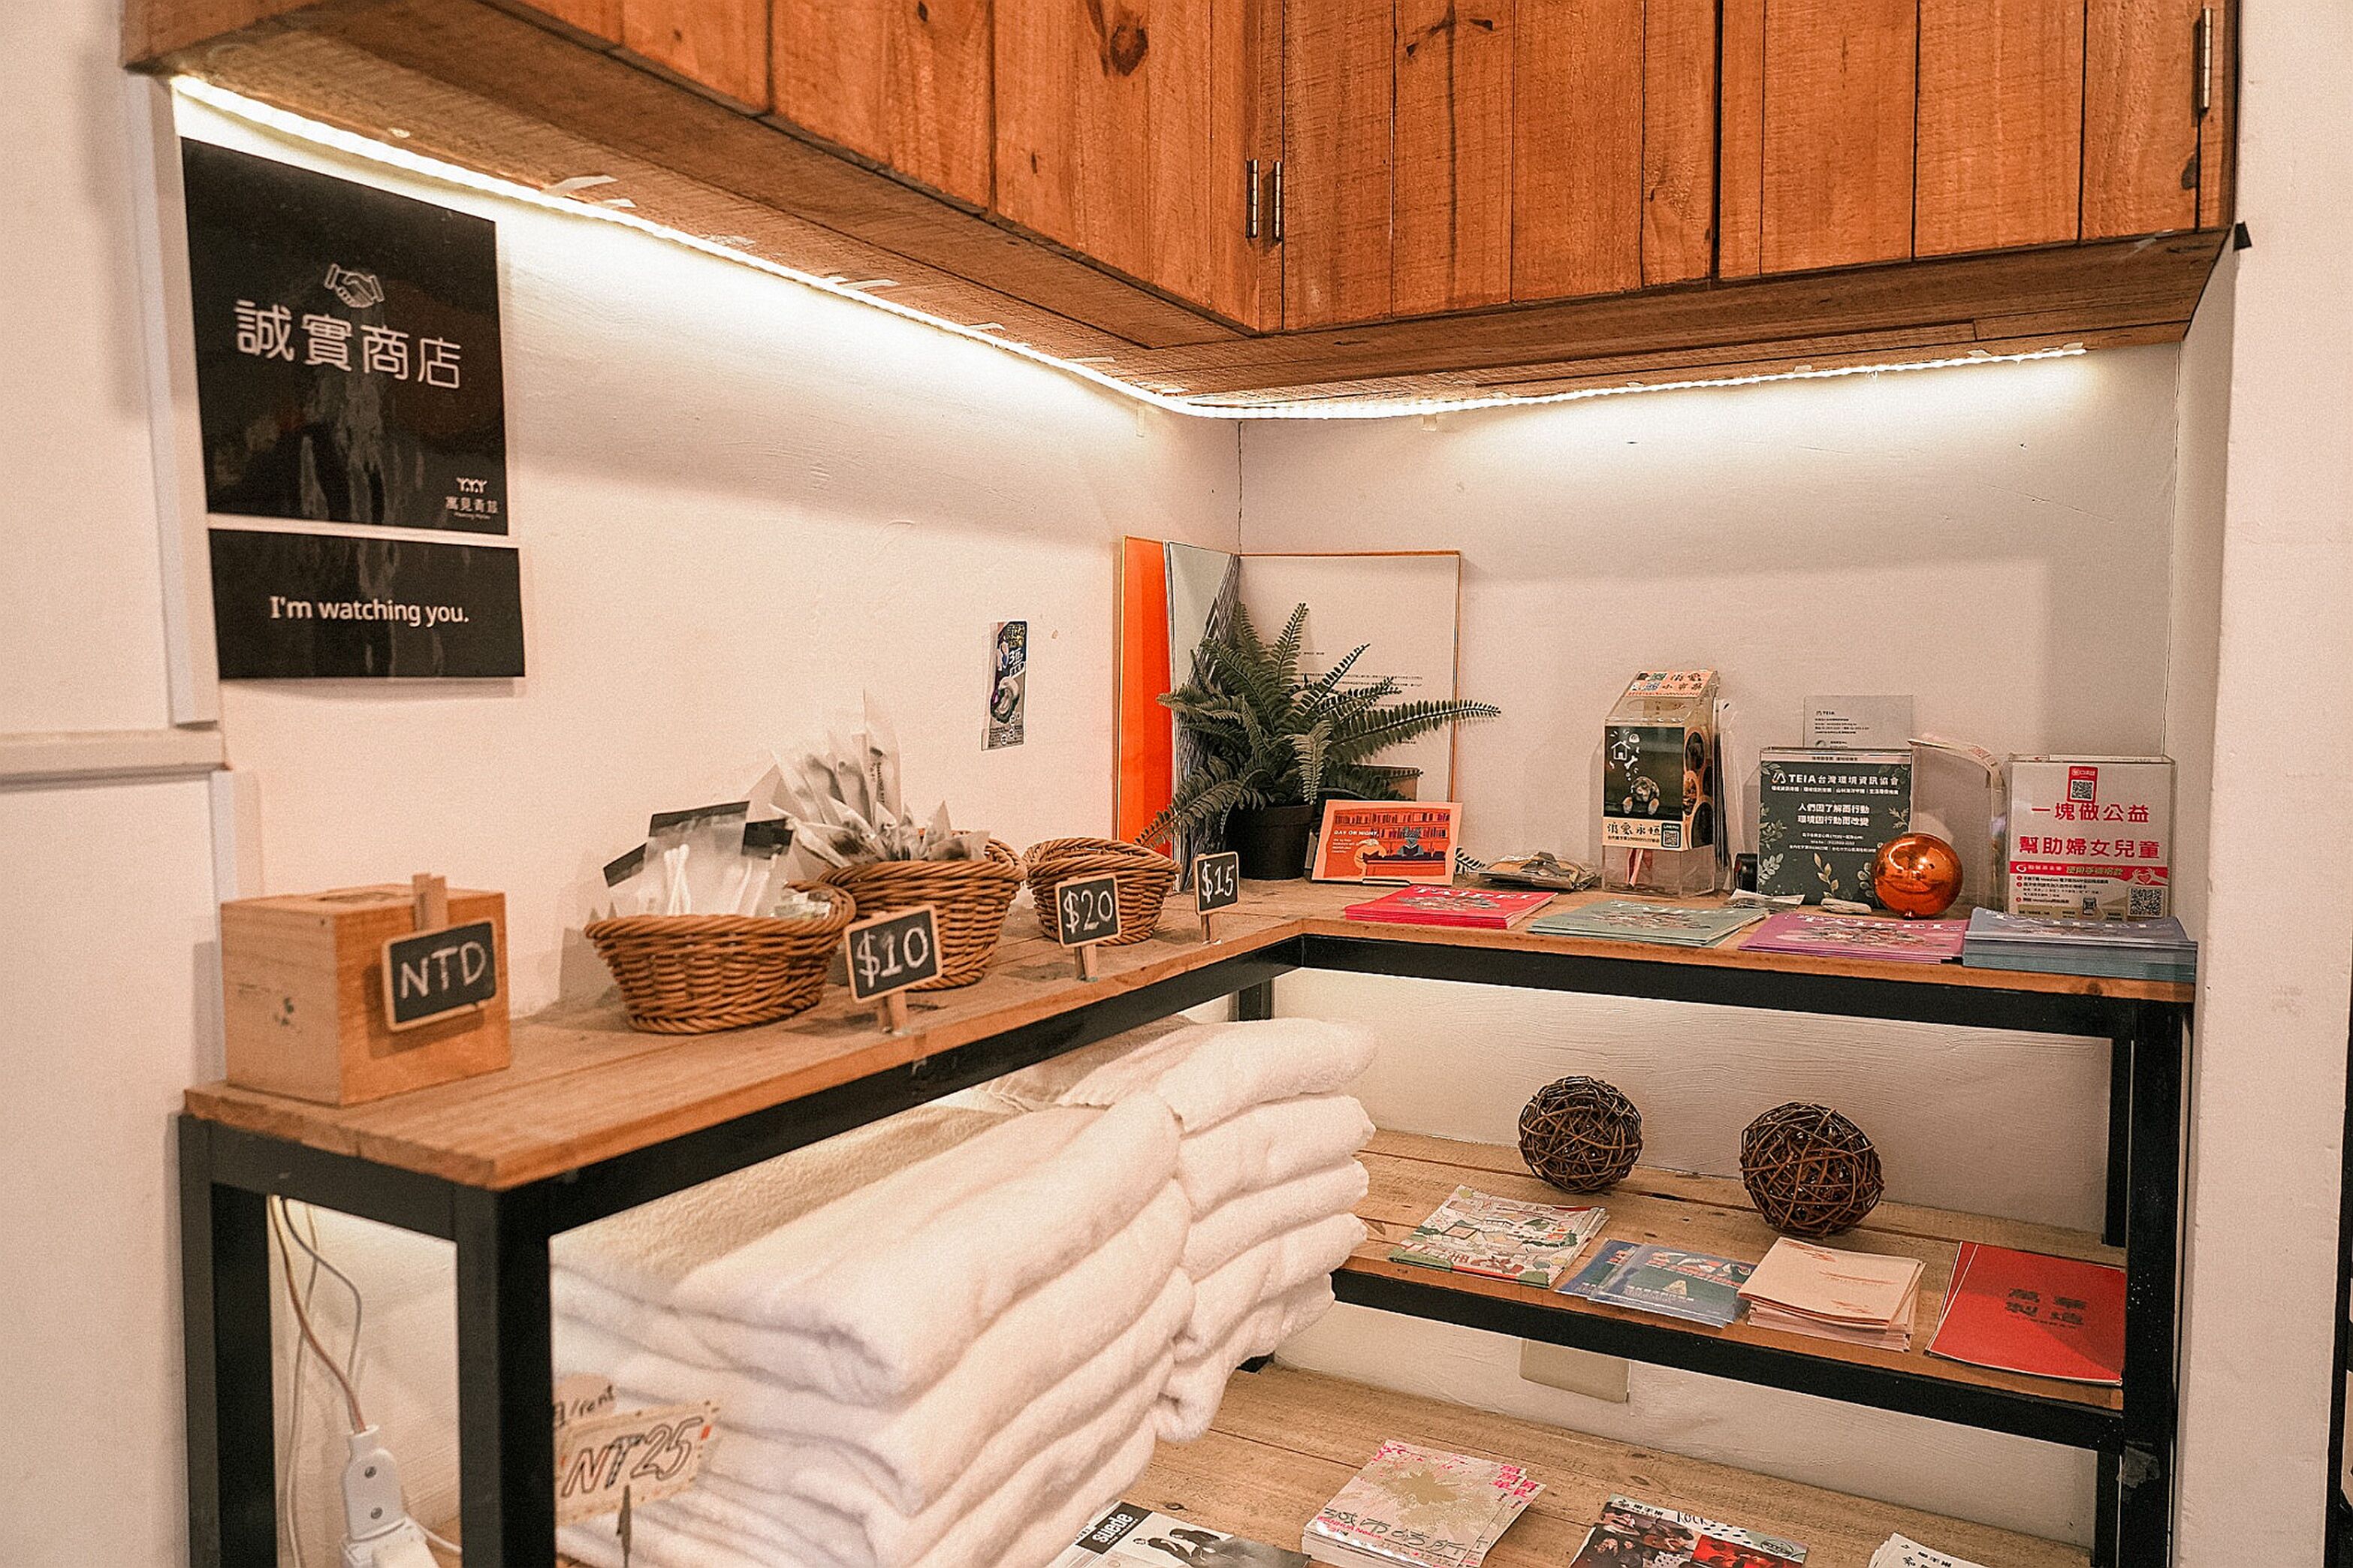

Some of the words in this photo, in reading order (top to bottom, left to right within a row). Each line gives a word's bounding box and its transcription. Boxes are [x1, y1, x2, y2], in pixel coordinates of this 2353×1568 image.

[234, 299, 461, 389] 誠實商店
[270, 596, 313, 620] I'm
[318, 599, 421, 627] watching
[424, 604, 470, 628] you.
[1797, 815, 1869, 827] 環境因行動而改變
[1798, 803, 1870, 814] 人們因了解而行動
[2032, 802, 2149, 823] 一塊做公益
[2019, 835, 2160, 859] 幫助婦女兒童
[1202, 861, 1235, 903] $15
[1063, 889, 1113, 934] $20
[400, 941, 487, 1000] NTD
[856, 927, 928, 988] $10
[560, 1416, 704, 1498] NT25
[1091, 1512, 1134, 1544] suede
